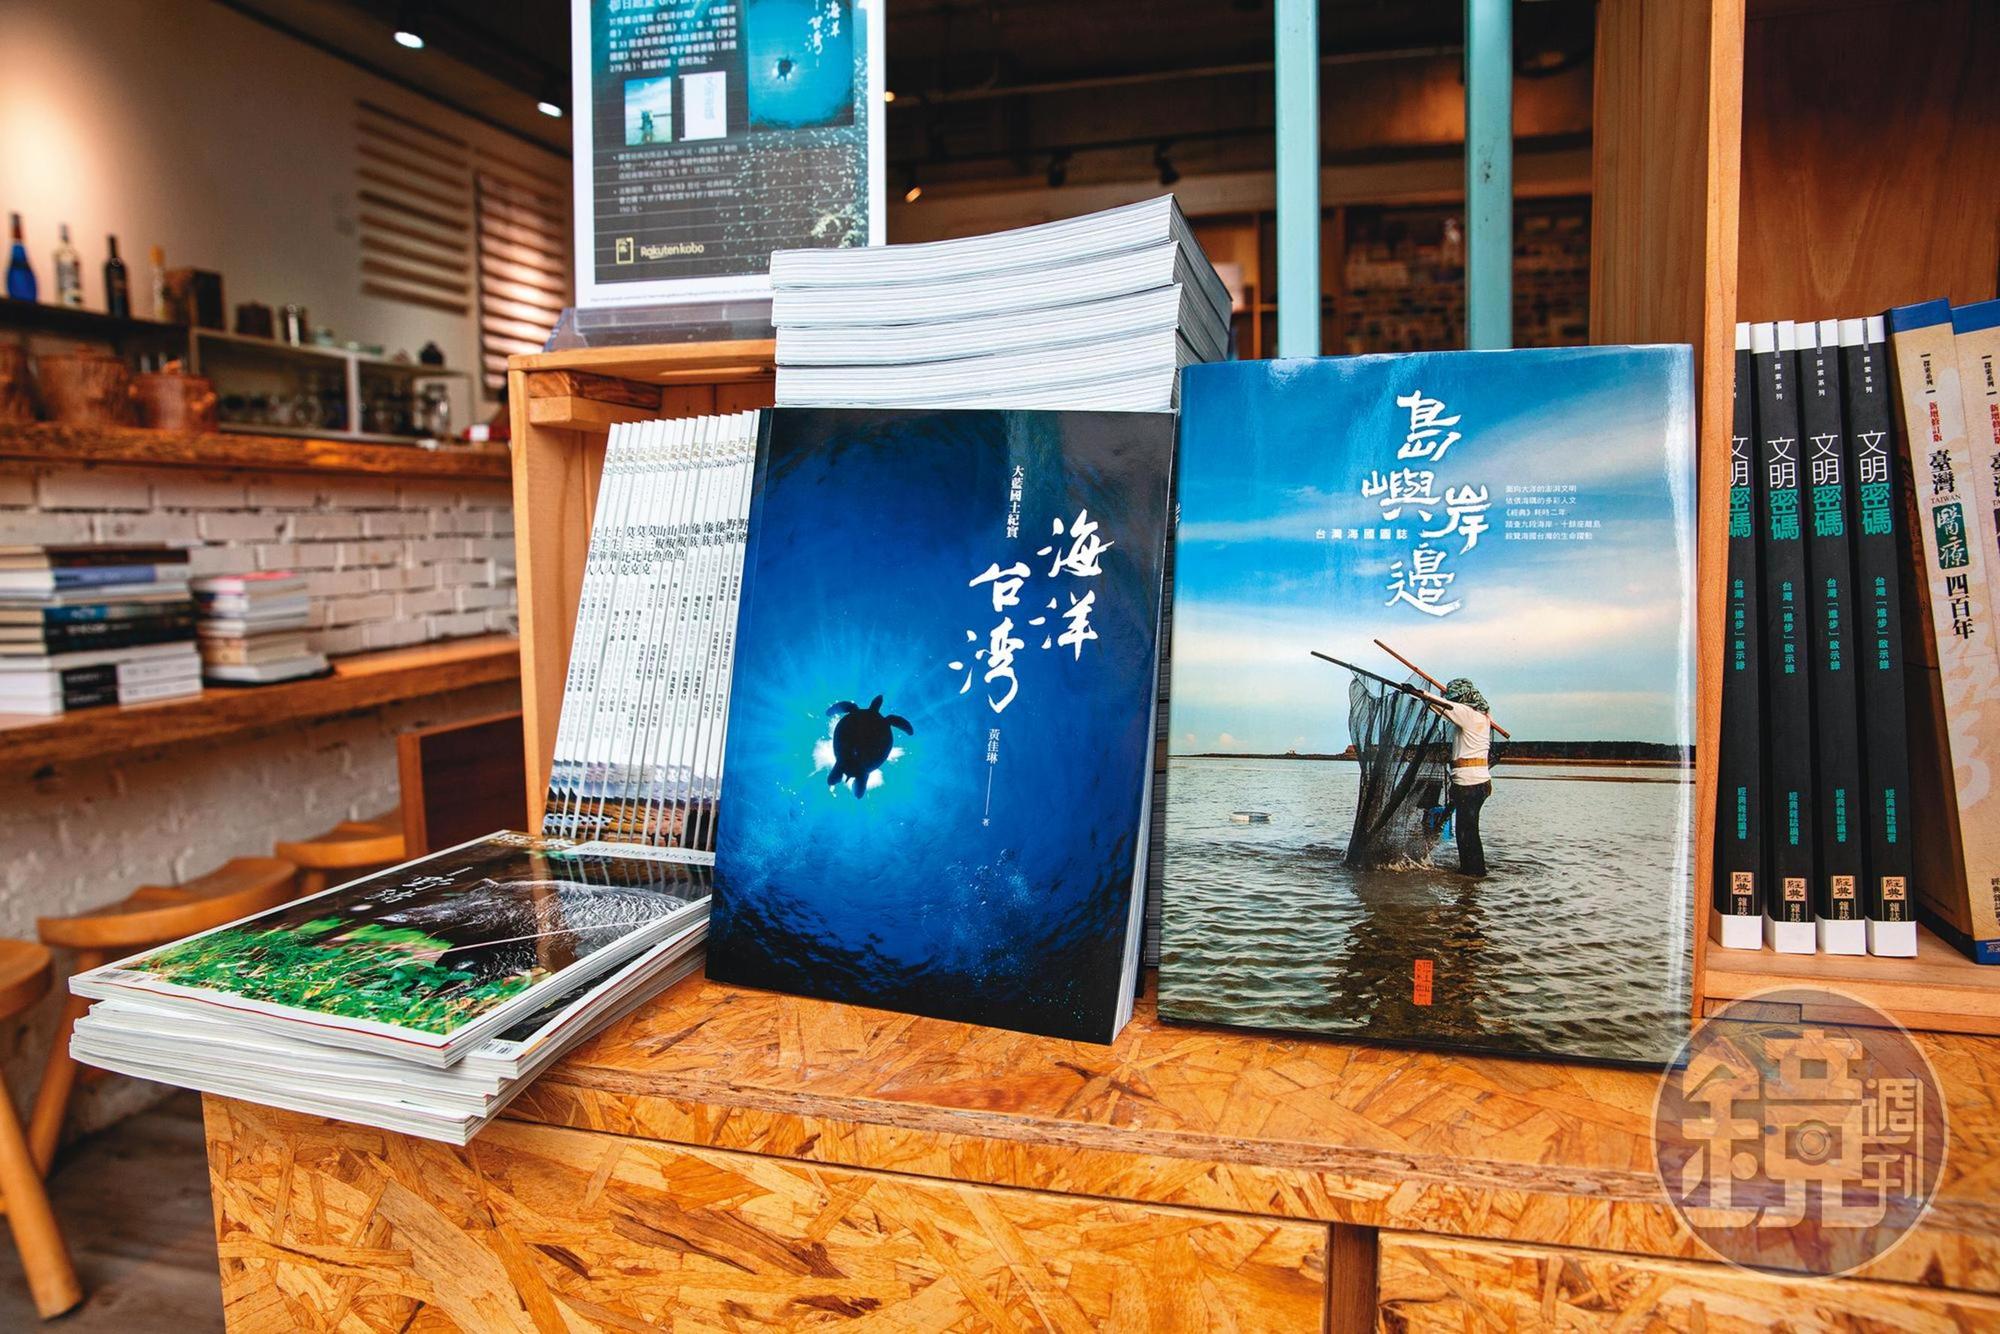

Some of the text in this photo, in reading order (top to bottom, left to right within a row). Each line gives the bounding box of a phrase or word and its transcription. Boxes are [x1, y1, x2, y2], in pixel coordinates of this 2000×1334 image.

[1006, 465, 1024, 539] 大藍國土紀實
[1767, 437, 1799, 540] 文明密碼
[1810, 433, 1843, 537] 文明密碼
[1857, 430, 1892, 536] 文明密碼
[1930, 493, 1961, 504] TAIWAN
[1028, 508, 1115, 662] 海洋
[986, 728, 1000, 765] 黃佳琳
